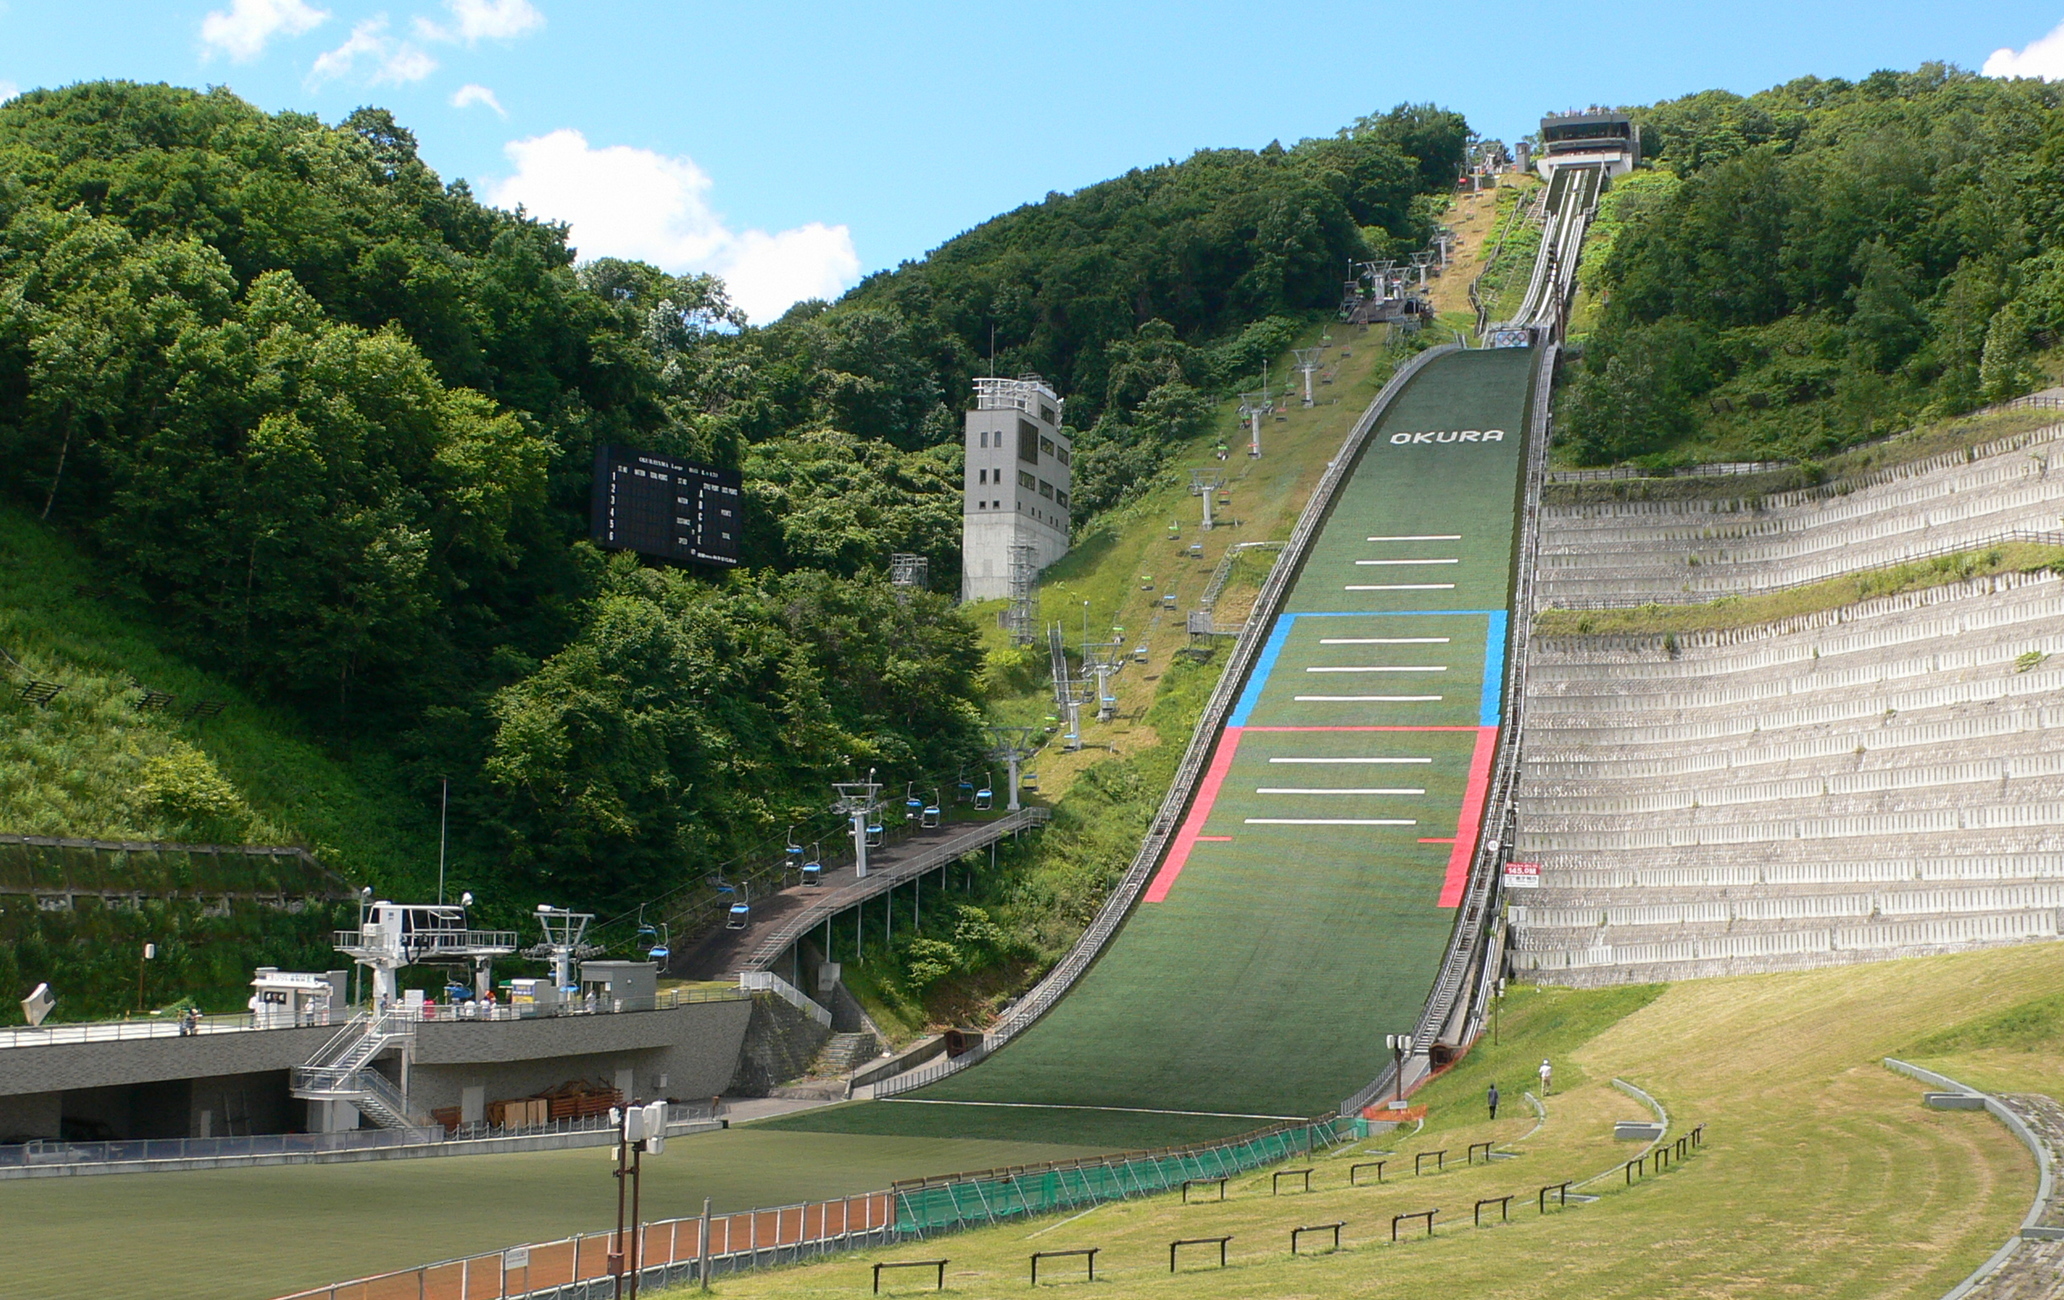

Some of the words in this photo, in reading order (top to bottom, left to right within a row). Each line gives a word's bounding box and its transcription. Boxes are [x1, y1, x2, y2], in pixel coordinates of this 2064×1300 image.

[1390, 430, 1504, 445] OKURA
[610, 484, 616, 493] 2
[610, 496, 615, 504] 3
[610, 508, 614, 516] 4
[610, 520, 614, 528] 5
